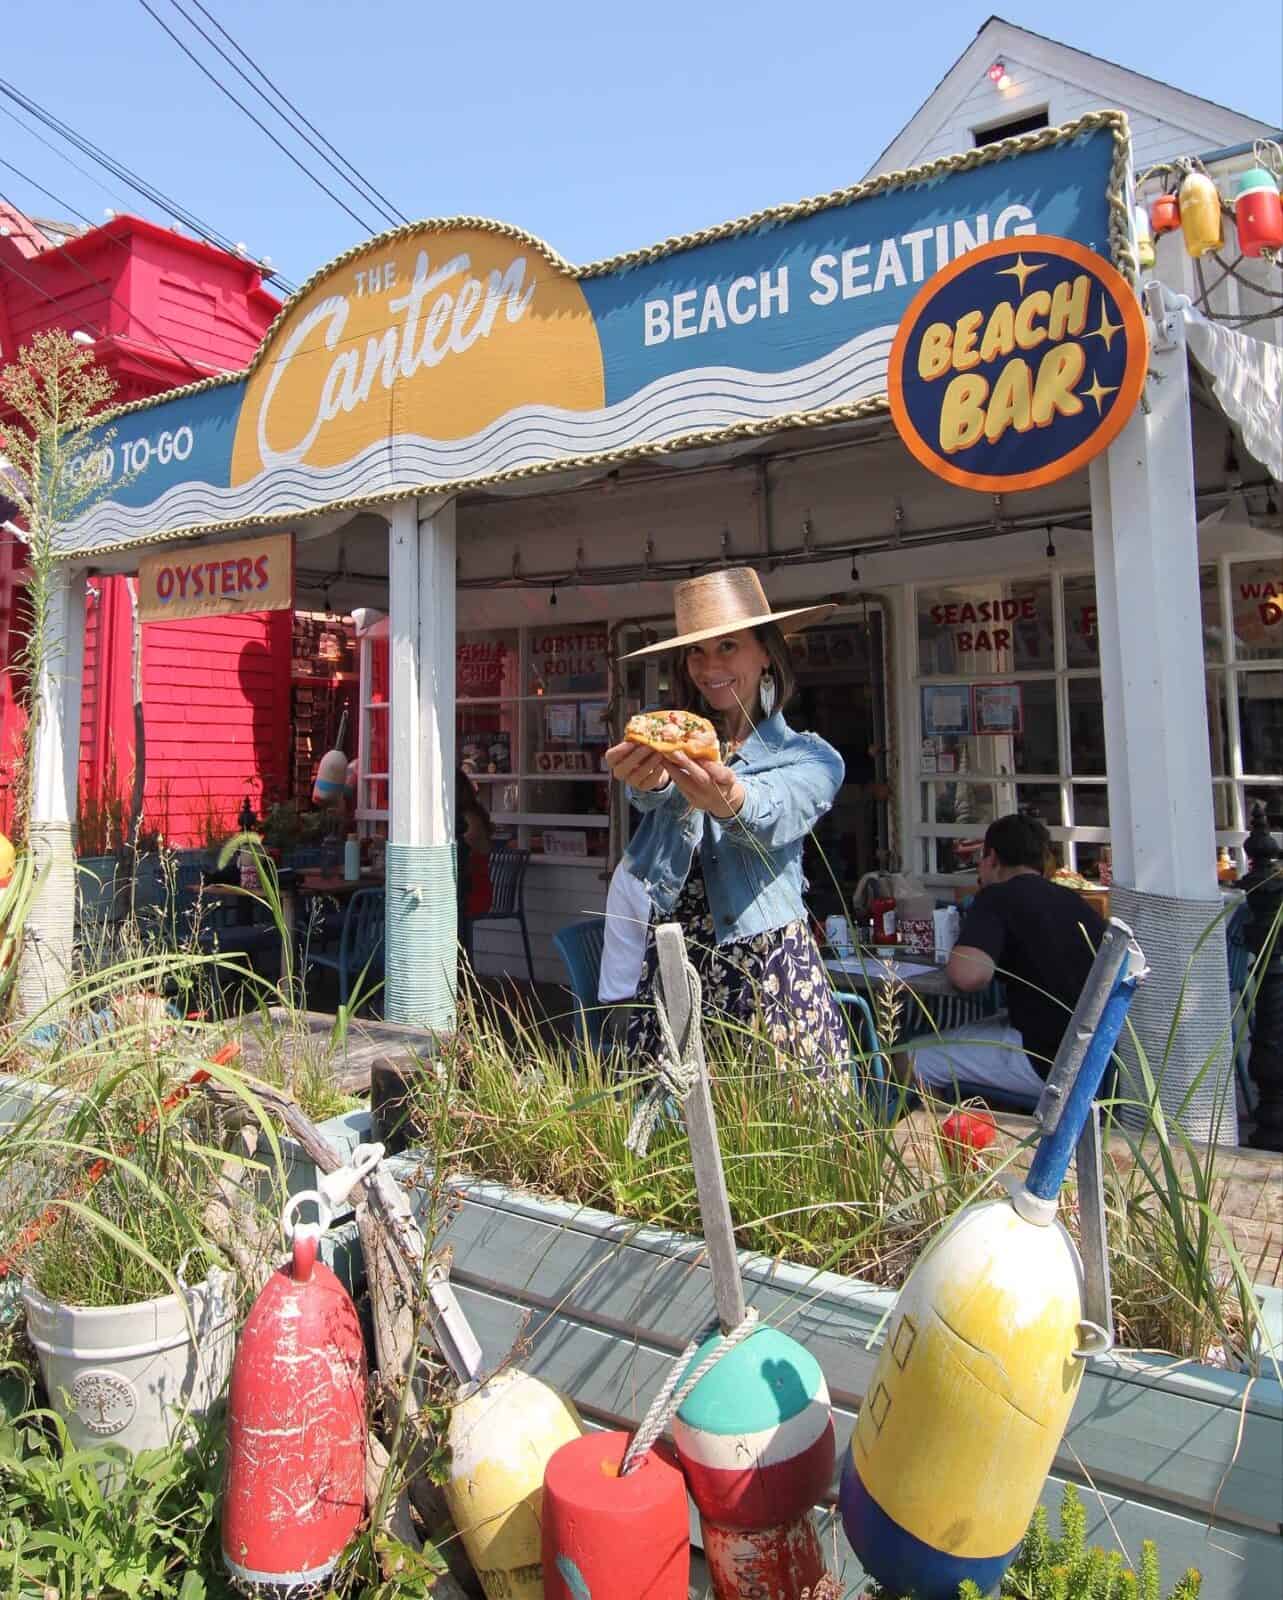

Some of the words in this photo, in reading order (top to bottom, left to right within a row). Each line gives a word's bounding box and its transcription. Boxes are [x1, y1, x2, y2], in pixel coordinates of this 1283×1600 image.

[354, 261, 397, 297] THE
[644, 267, 789, 347] BEACH
[918, 274, 1092, 382] BEACH
[256, 250, 537, 468] Canteen
[939, 342, 1086, 455] BAR
[62, 446, 115, 489] OOD
[121, 425, 194, 475] TO-GO
[156, 553, 269, 602] OYSTERS
[930, 598, 1037, 625] SEASIDE
[956, 629, 1011, 652] BAR
[538, 752, 587, 771] OPEN
